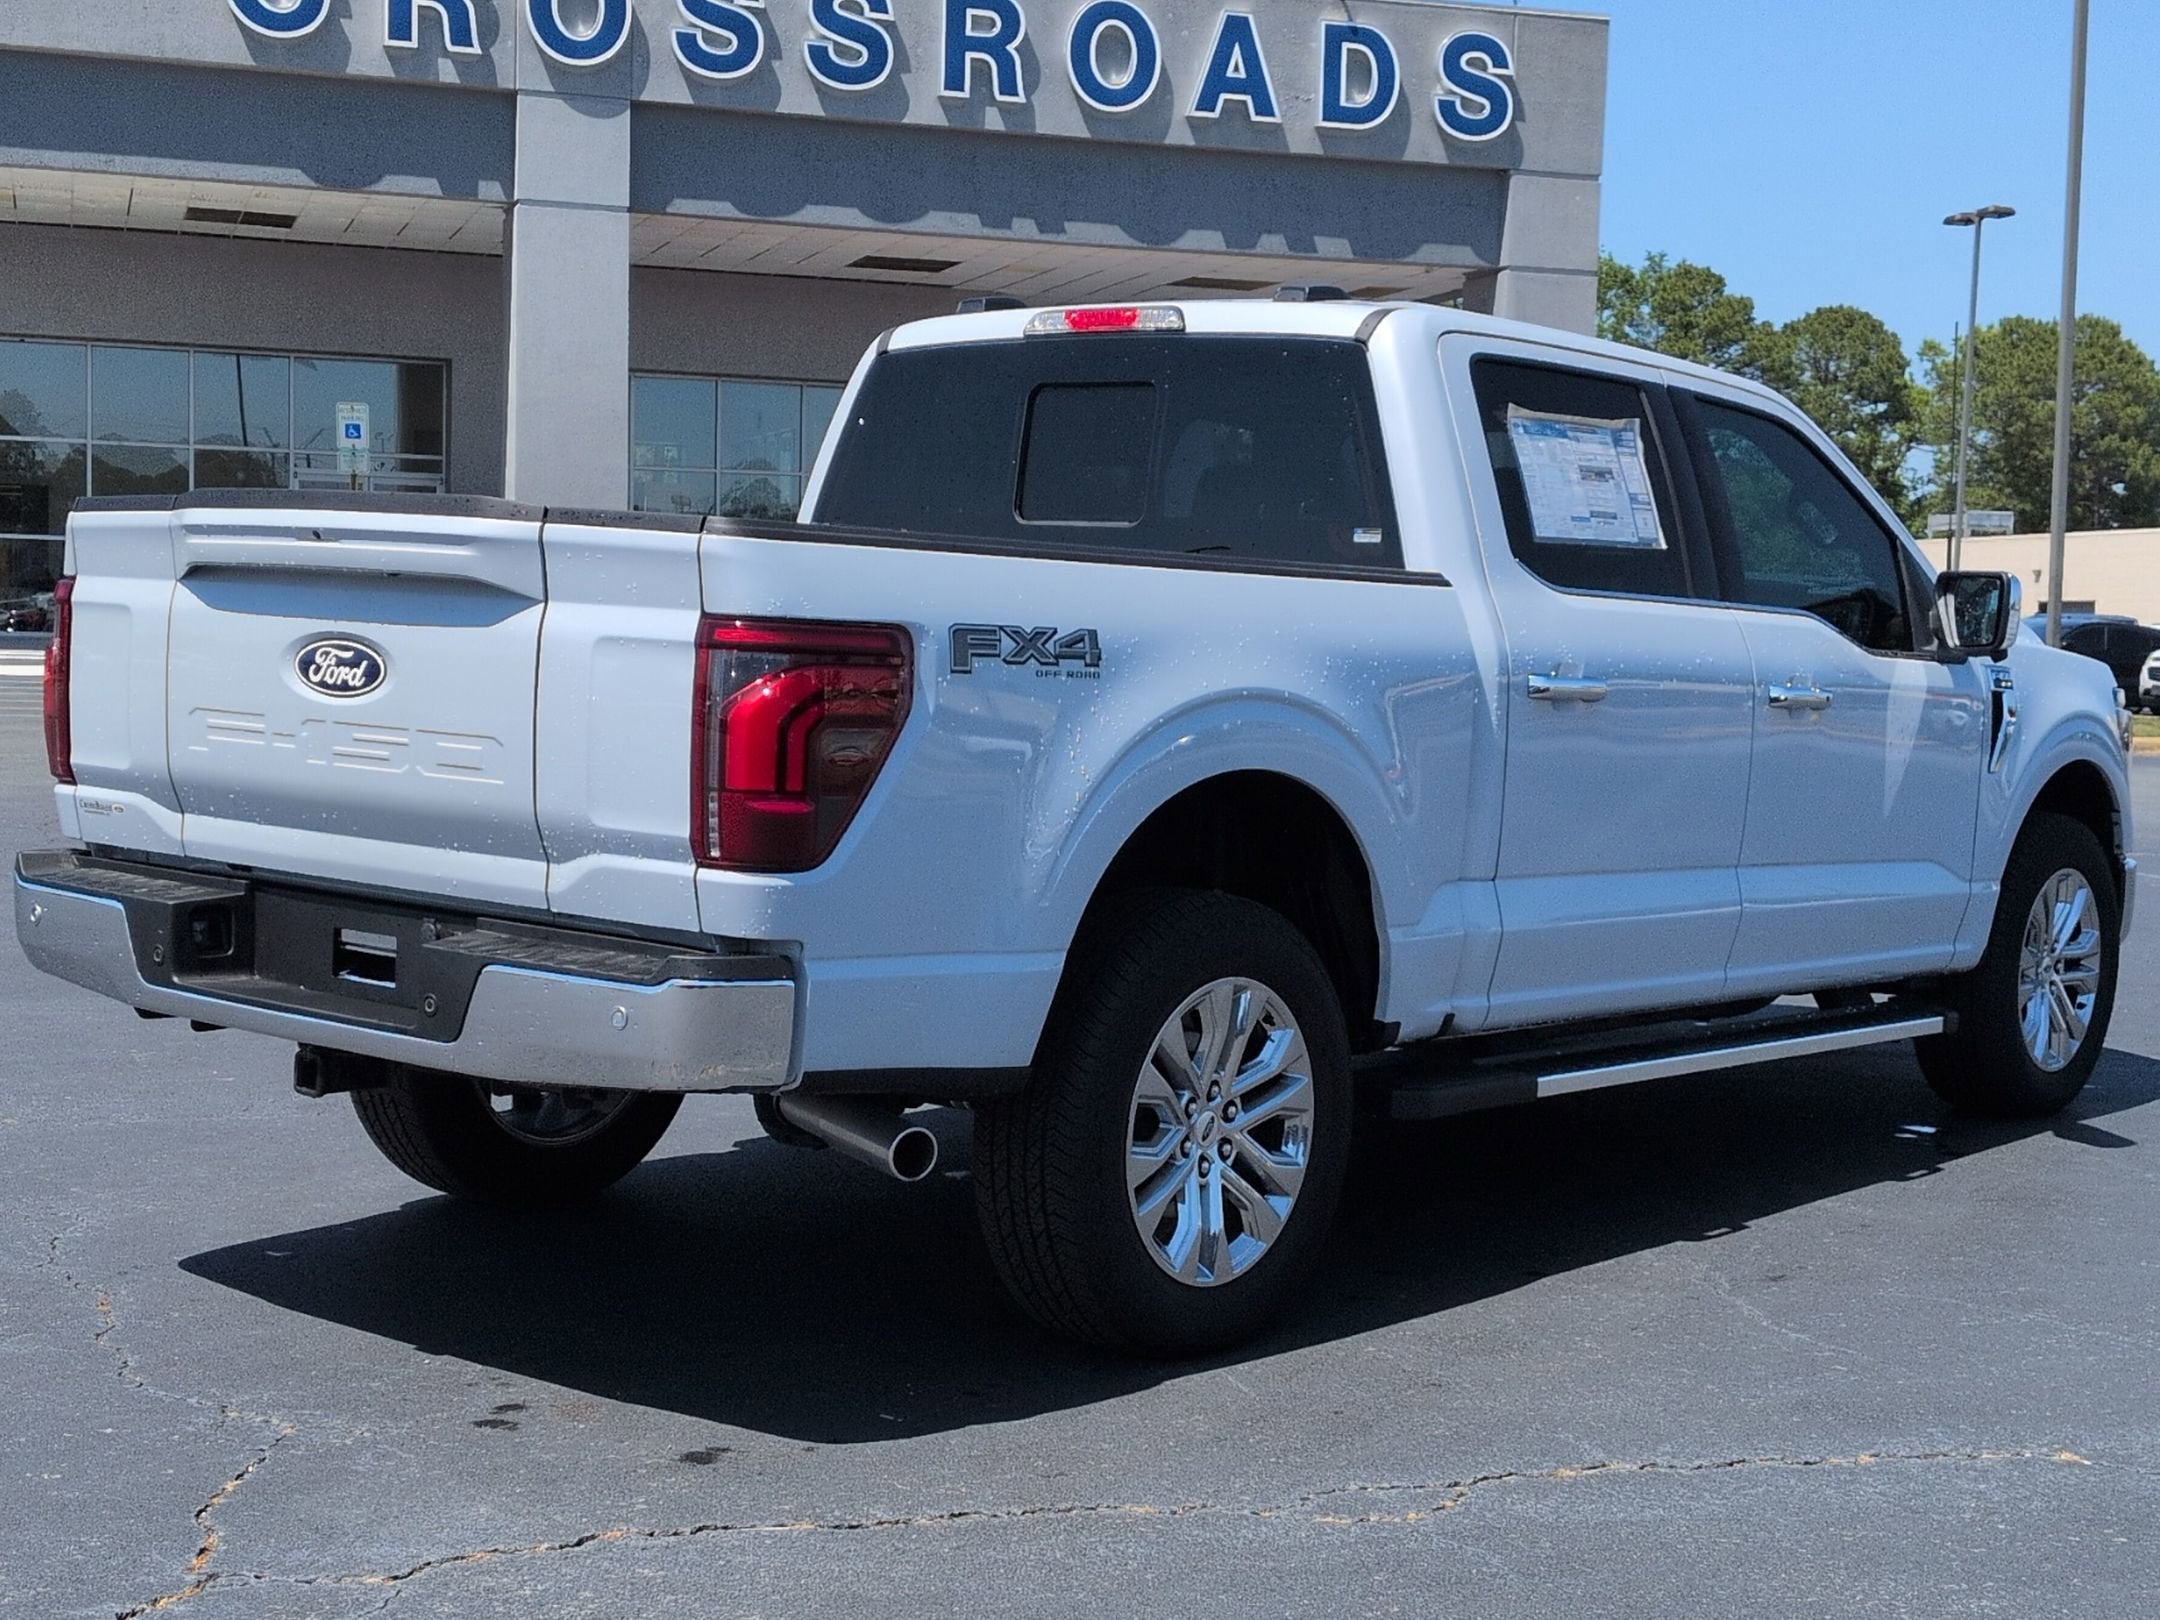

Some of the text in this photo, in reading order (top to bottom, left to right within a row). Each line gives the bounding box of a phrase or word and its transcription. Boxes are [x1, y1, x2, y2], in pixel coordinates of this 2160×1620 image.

[308, 646, 368, 688] Ford
[949, 623, 1102, 674] FX4
[1035, 669, 1101, 680] OFF ROAD
